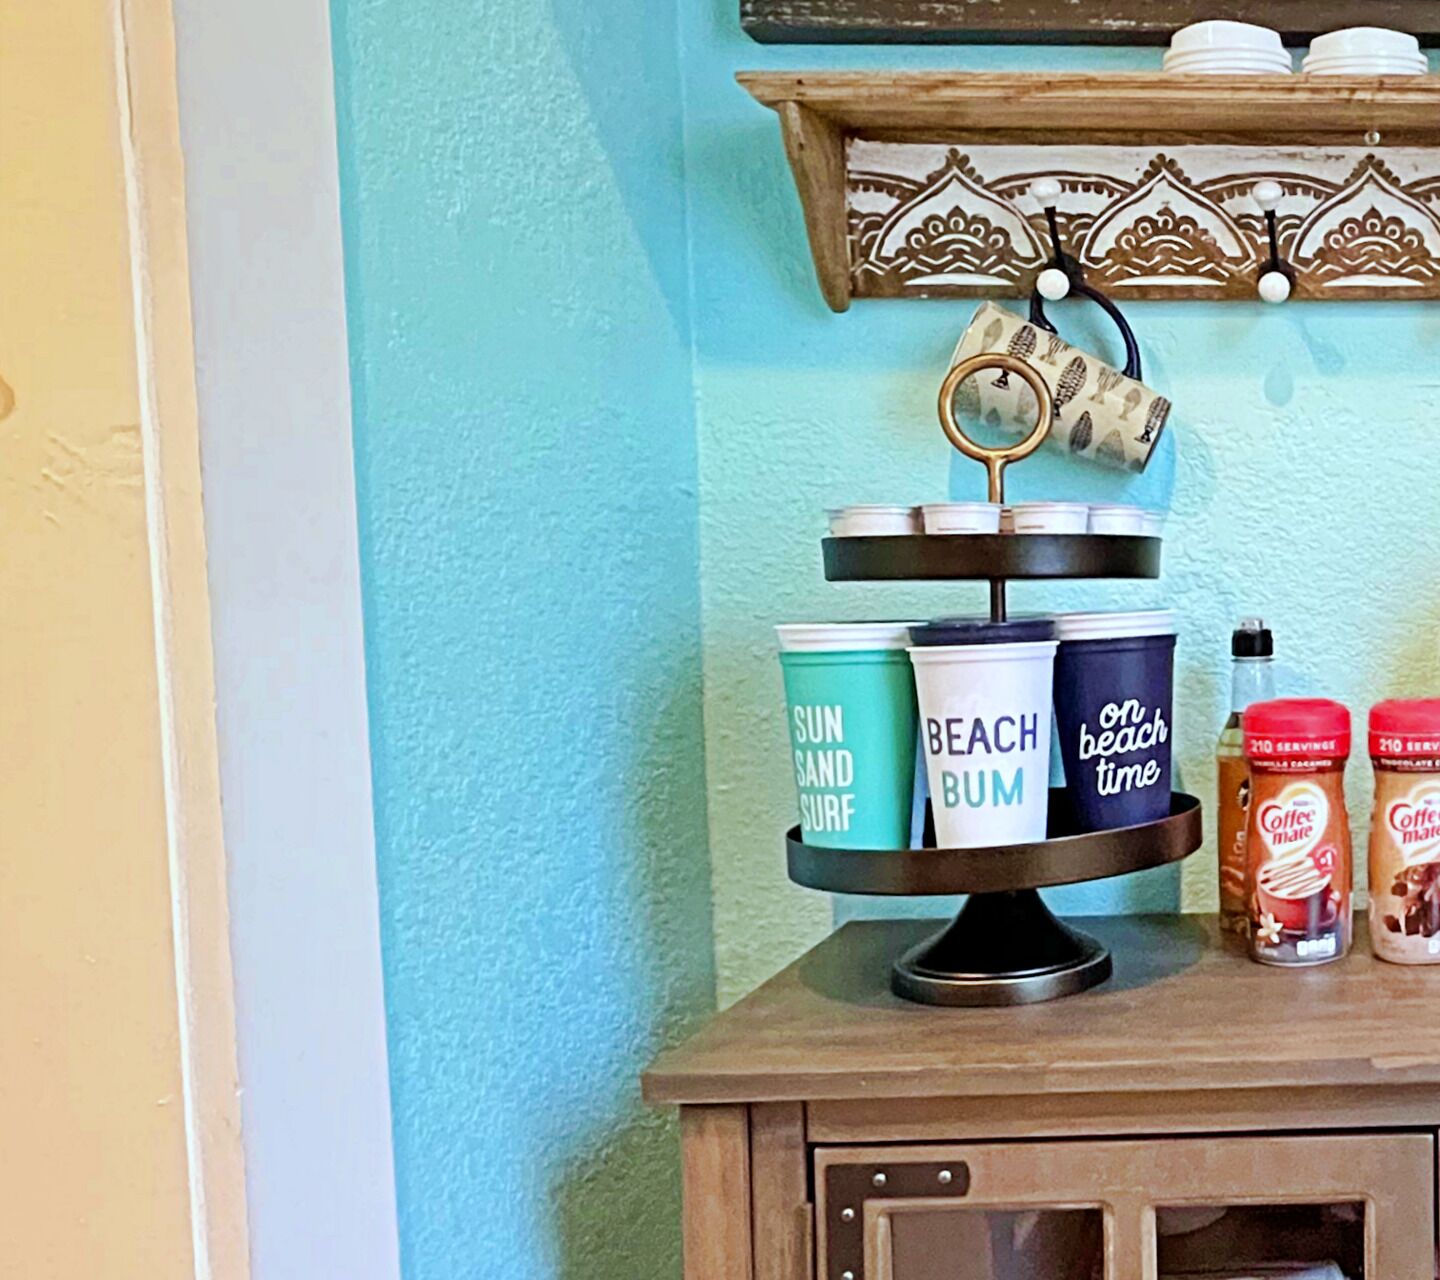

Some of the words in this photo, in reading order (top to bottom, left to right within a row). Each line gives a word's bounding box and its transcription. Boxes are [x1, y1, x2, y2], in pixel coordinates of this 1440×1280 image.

[793, 704, 844, 744] SUN
[1099, 698, 1147, 730] on
[927, 713, 1038, 756] BEACH
[1079, 708, 1169, 761] beach
[1251, 740, 1273, 754] 210
[1380, 738, 1402, 752] 210
[797, 749, 853, 788] SAND
[943, 766, 1024, 808] BUM
[1096, 756, 1161, 796] time
[800, 794, 856, 833] SURF
[1261, 804, 1314, 833] Coffee
[1272, 825, 1313, 845] mate
